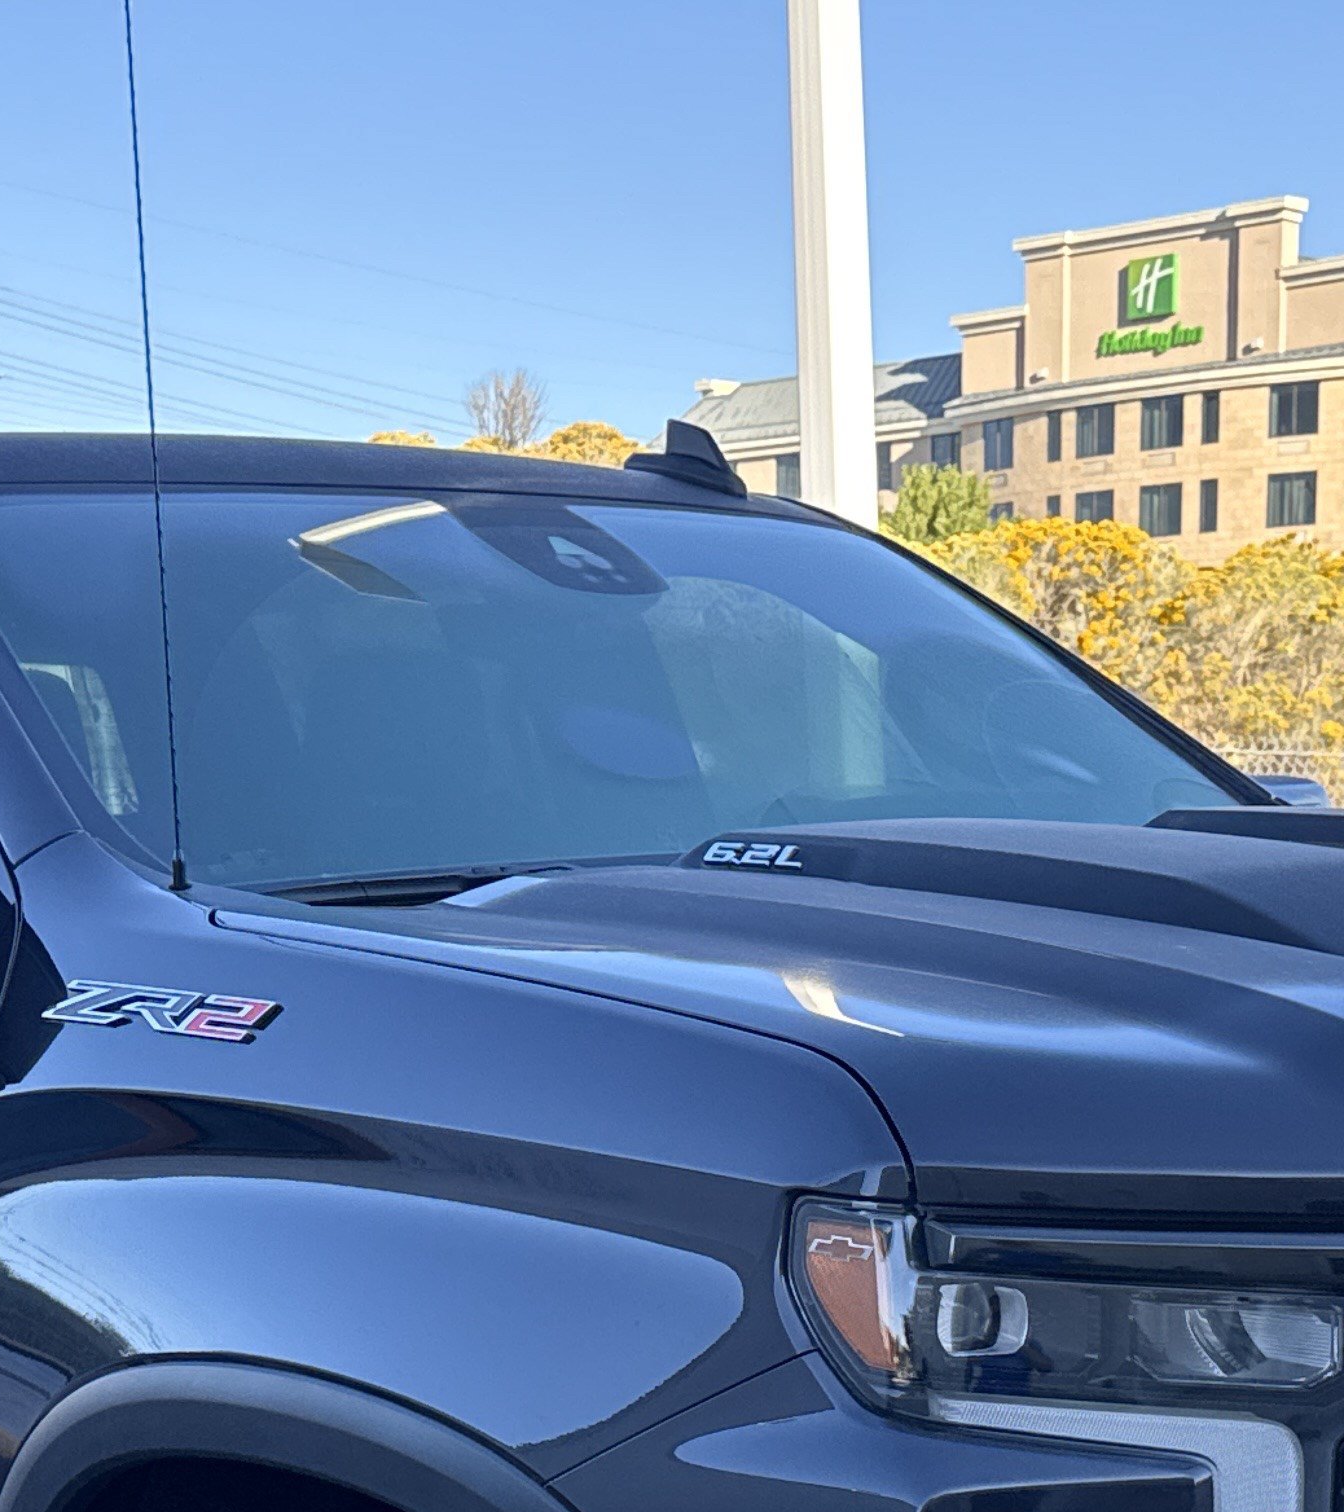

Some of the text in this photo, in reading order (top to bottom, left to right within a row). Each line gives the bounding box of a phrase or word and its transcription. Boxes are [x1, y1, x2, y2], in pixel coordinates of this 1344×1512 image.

[1097, 322, 1204, 357] Holiday Inn
[702, 841, 803, 869] 6.2L
[40, 979, 279, 1043] ZR2
